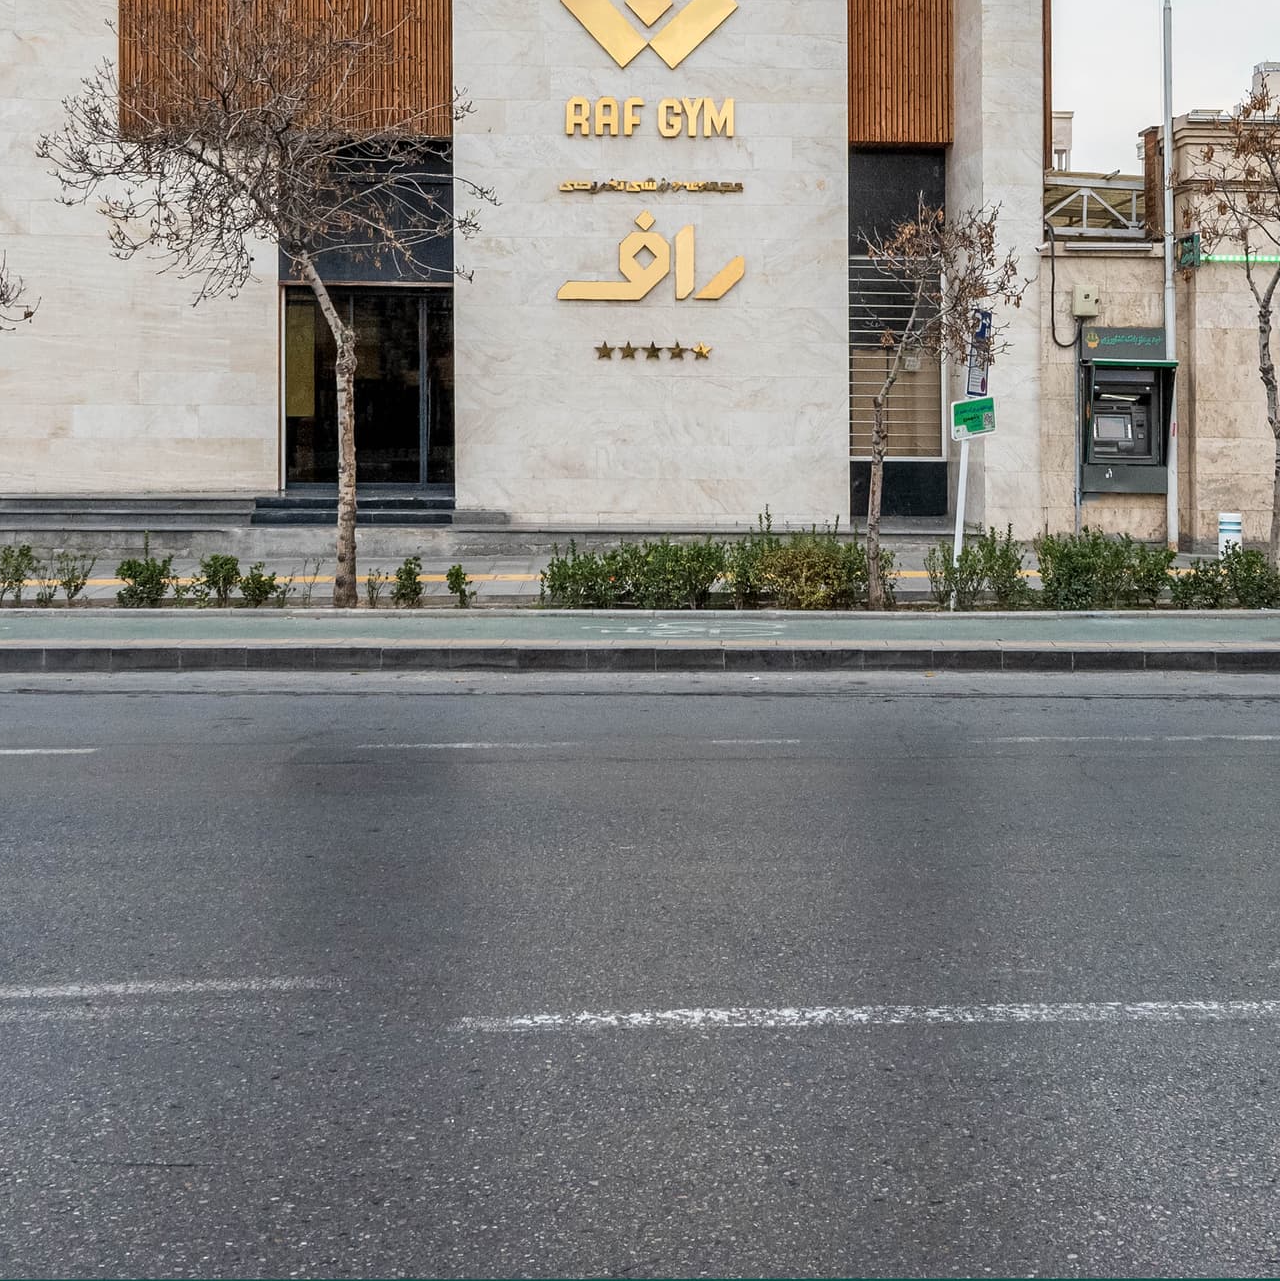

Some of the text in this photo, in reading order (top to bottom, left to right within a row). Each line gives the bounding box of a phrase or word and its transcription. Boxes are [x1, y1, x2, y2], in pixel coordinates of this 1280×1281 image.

[565, 95, 735, 138] RAF GYM
[556, 209, 746, 301] راف
